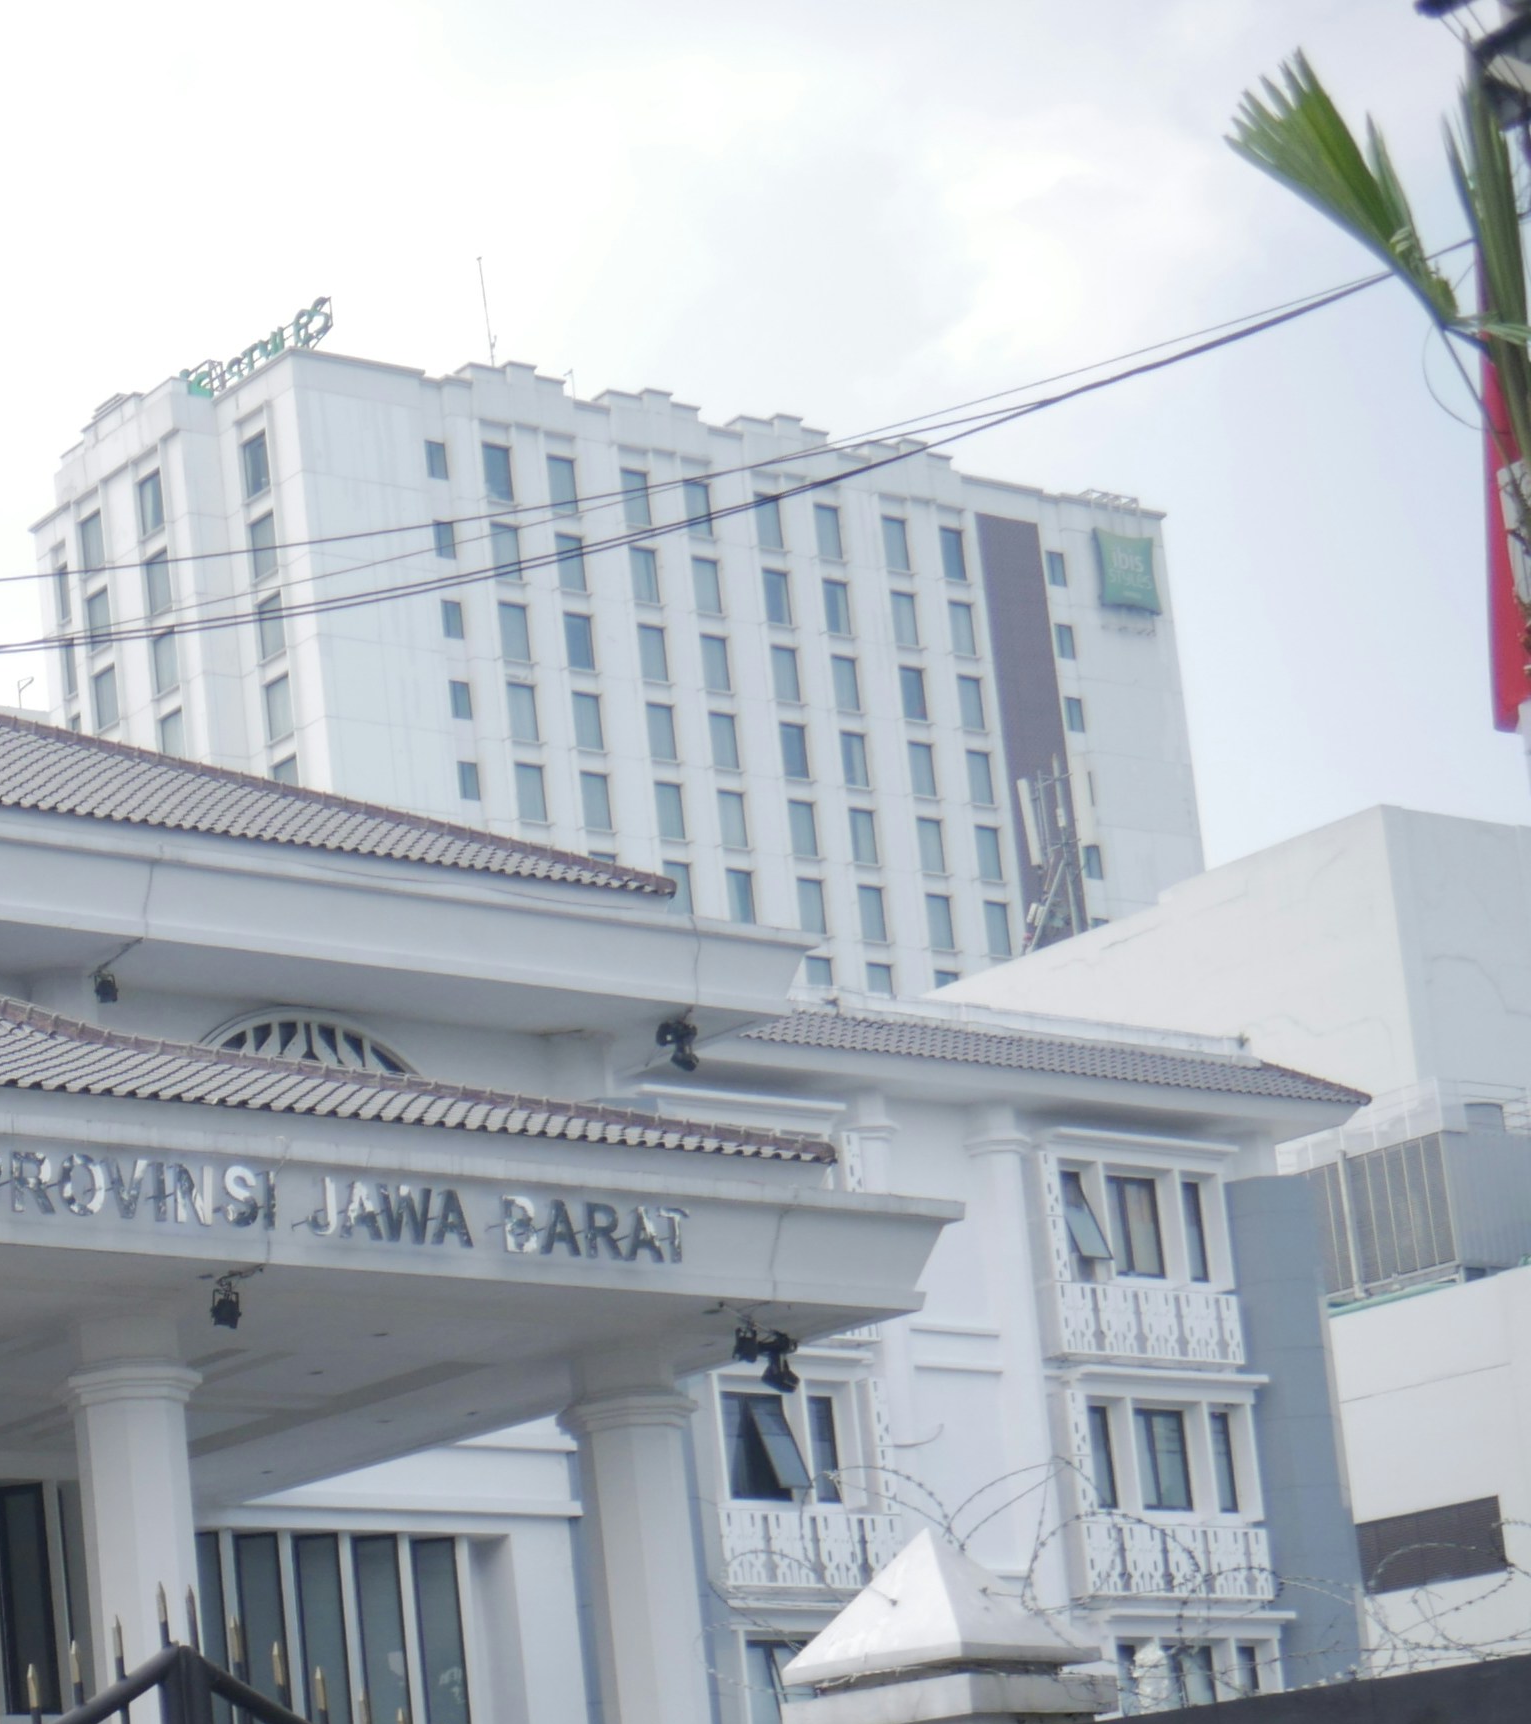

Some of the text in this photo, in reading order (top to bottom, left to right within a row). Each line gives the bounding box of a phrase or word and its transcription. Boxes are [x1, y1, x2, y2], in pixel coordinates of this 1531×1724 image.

[1111, 543, 1145, 573] ibis
[310, 1175, 474, 1249] JAWA
[500, 1194, 690, 1265] BARAT
